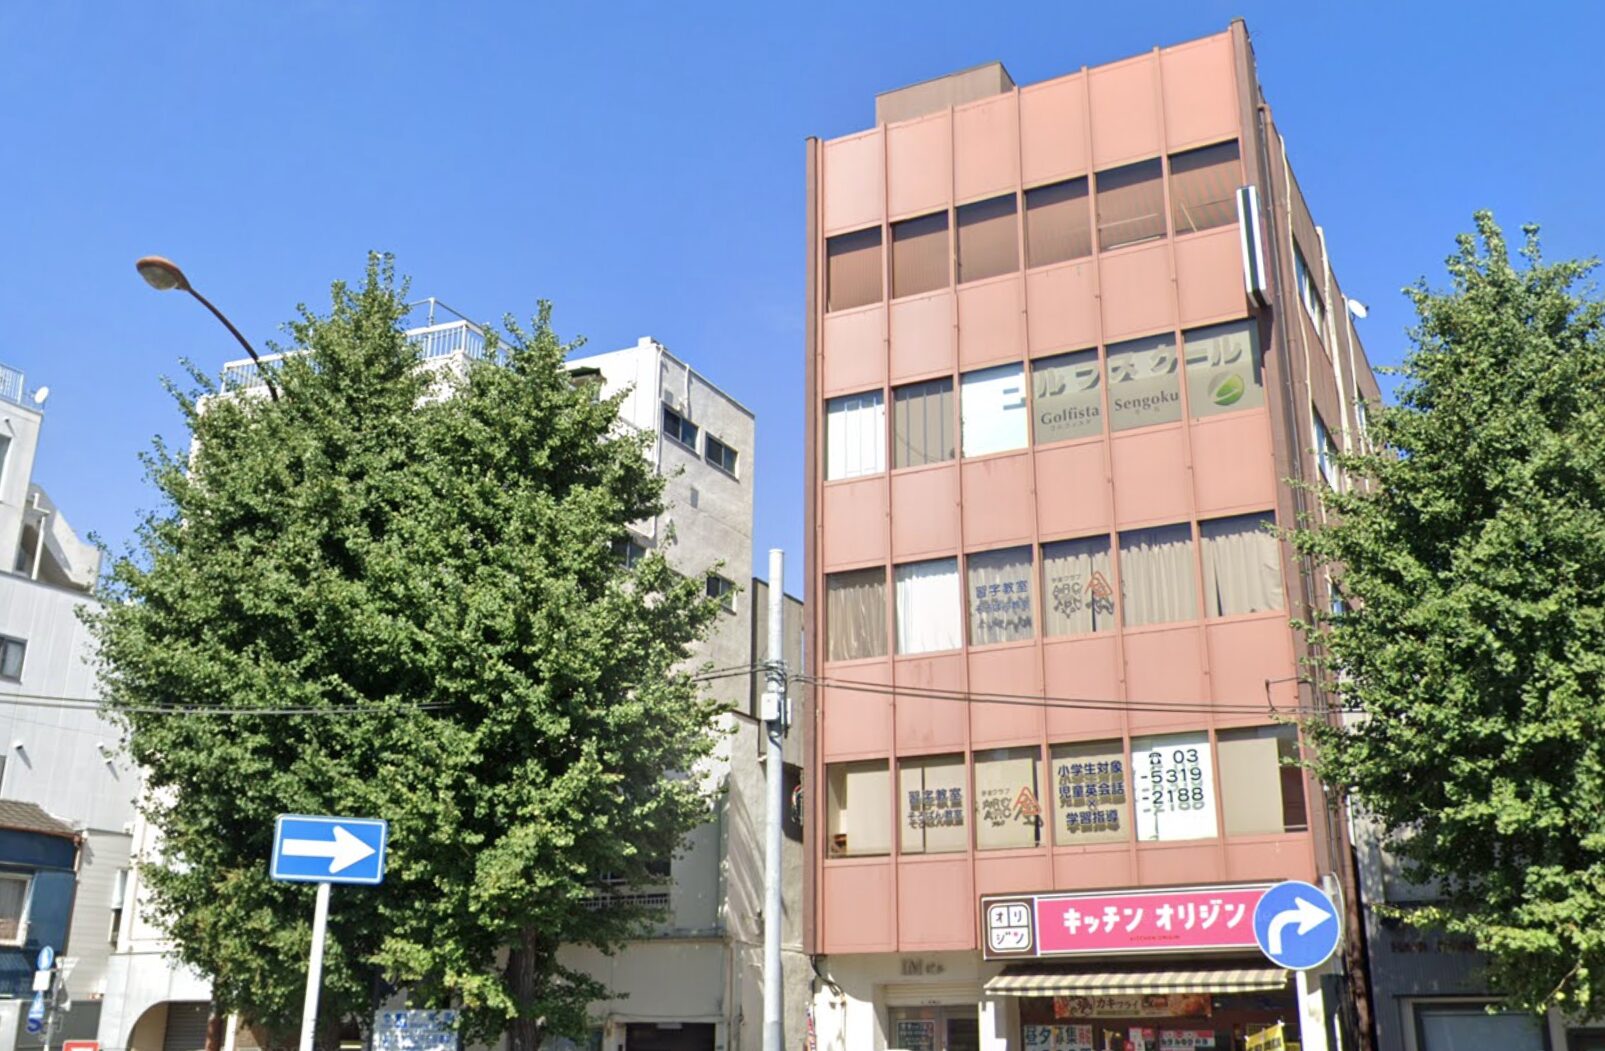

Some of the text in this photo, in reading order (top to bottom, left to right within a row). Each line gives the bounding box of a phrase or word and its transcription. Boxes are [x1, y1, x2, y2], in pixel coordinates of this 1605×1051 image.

[1040, 391, 1179, 425] Golfista Sengoku
[976, 580, 1027, 599] 習字教室
[1172, 749, 1198, 764] 03
[1057, 760, 1123, 778] 小学生対象
[1140, 767, 1202, 784] -5319
[908, 788, 961, 806] 習字教室
[1059, 782, 1124, 799] 児童英会話
[1142, 787, 1204, 804] -2188
[1066, 810, 1118, 826] 学習指導
[1063, 900, 1245, 935] キッチン オリジン
